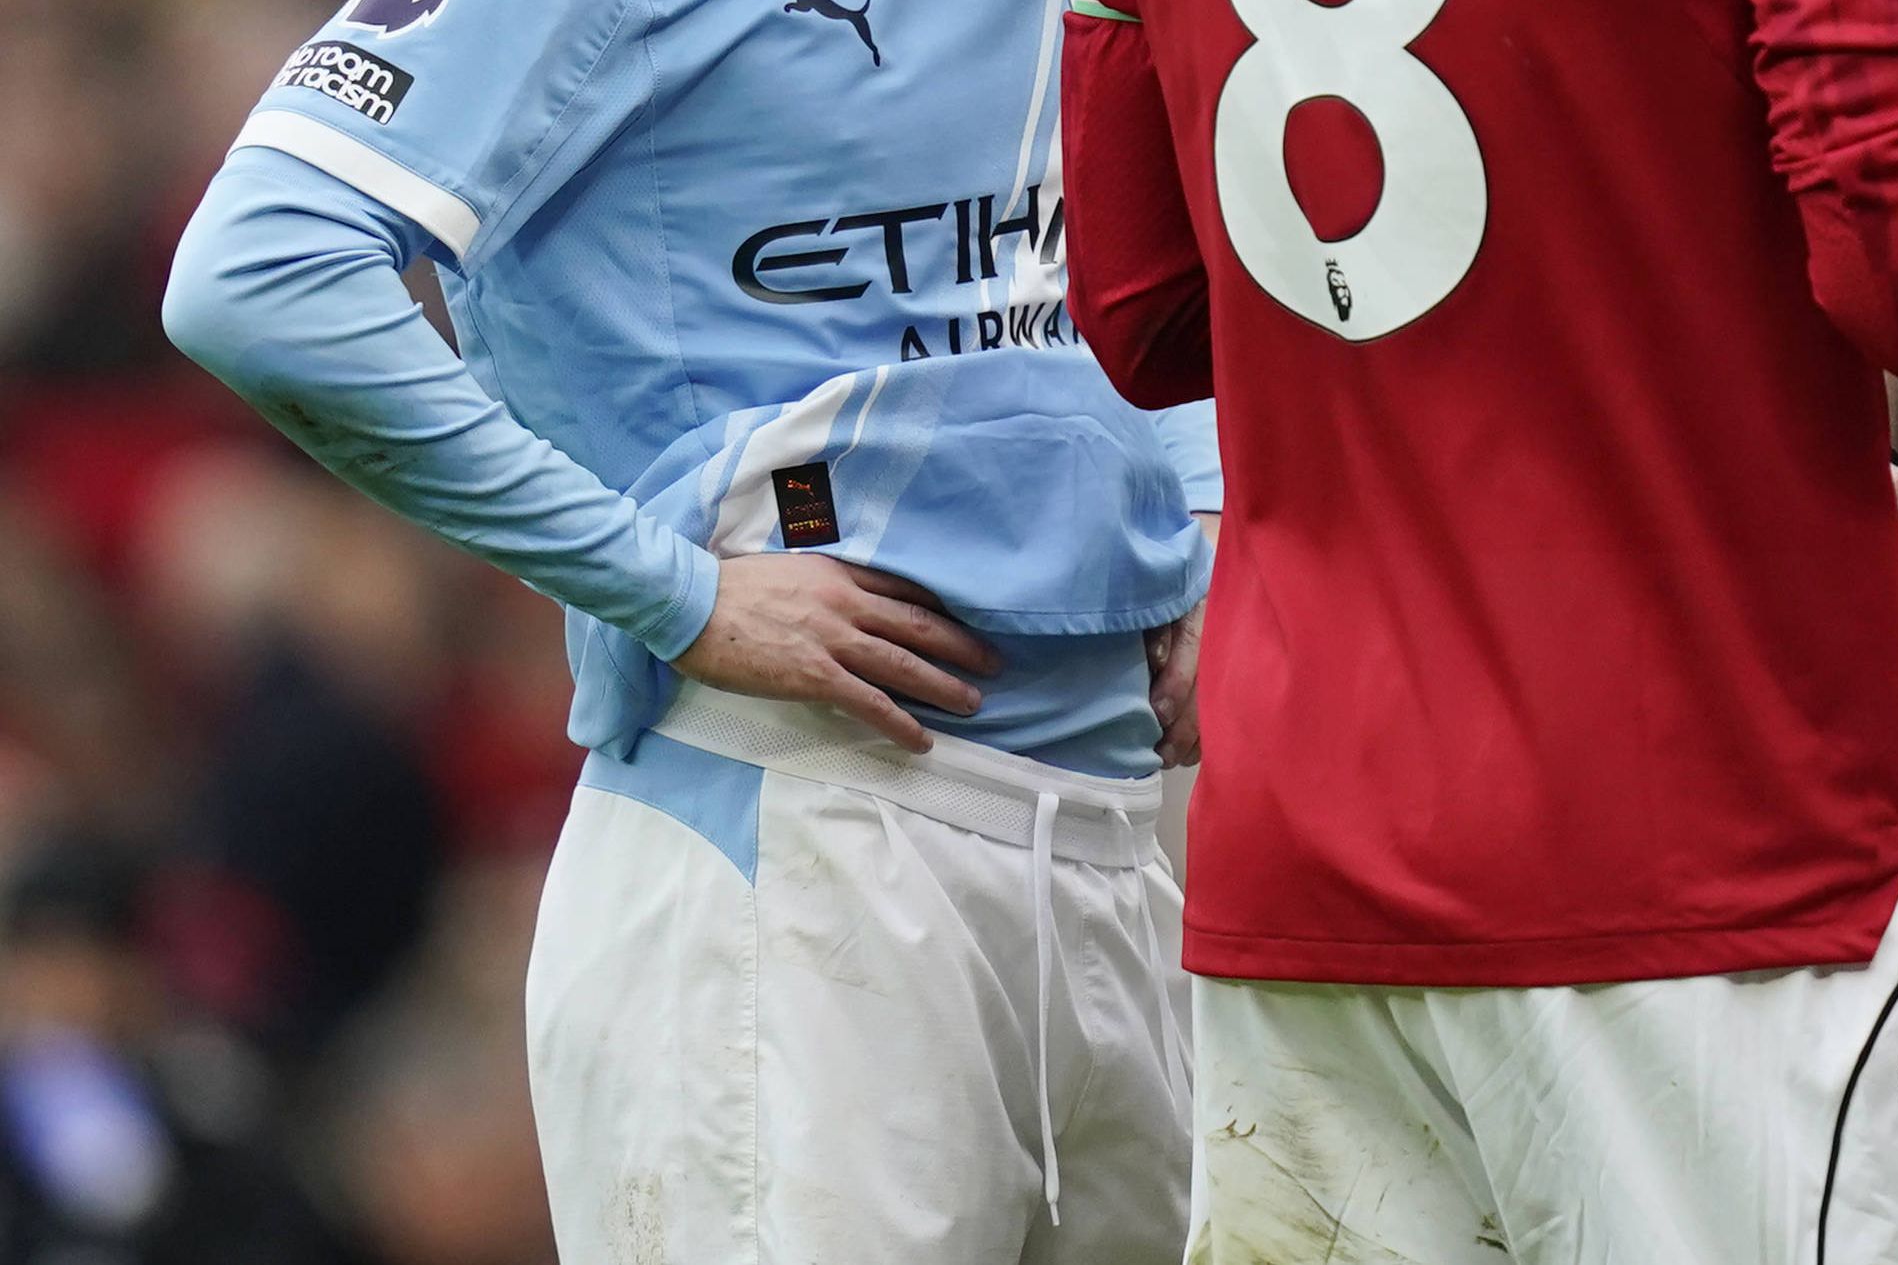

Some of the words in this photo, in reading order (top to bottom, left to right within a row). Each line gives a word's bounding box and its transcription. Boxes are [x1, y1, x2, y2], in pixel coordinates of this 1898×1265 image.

[293, 66, 394, 124] racism
[310, 46, 394, 95] room
[901, 299, 1079, 362] AIRWA
